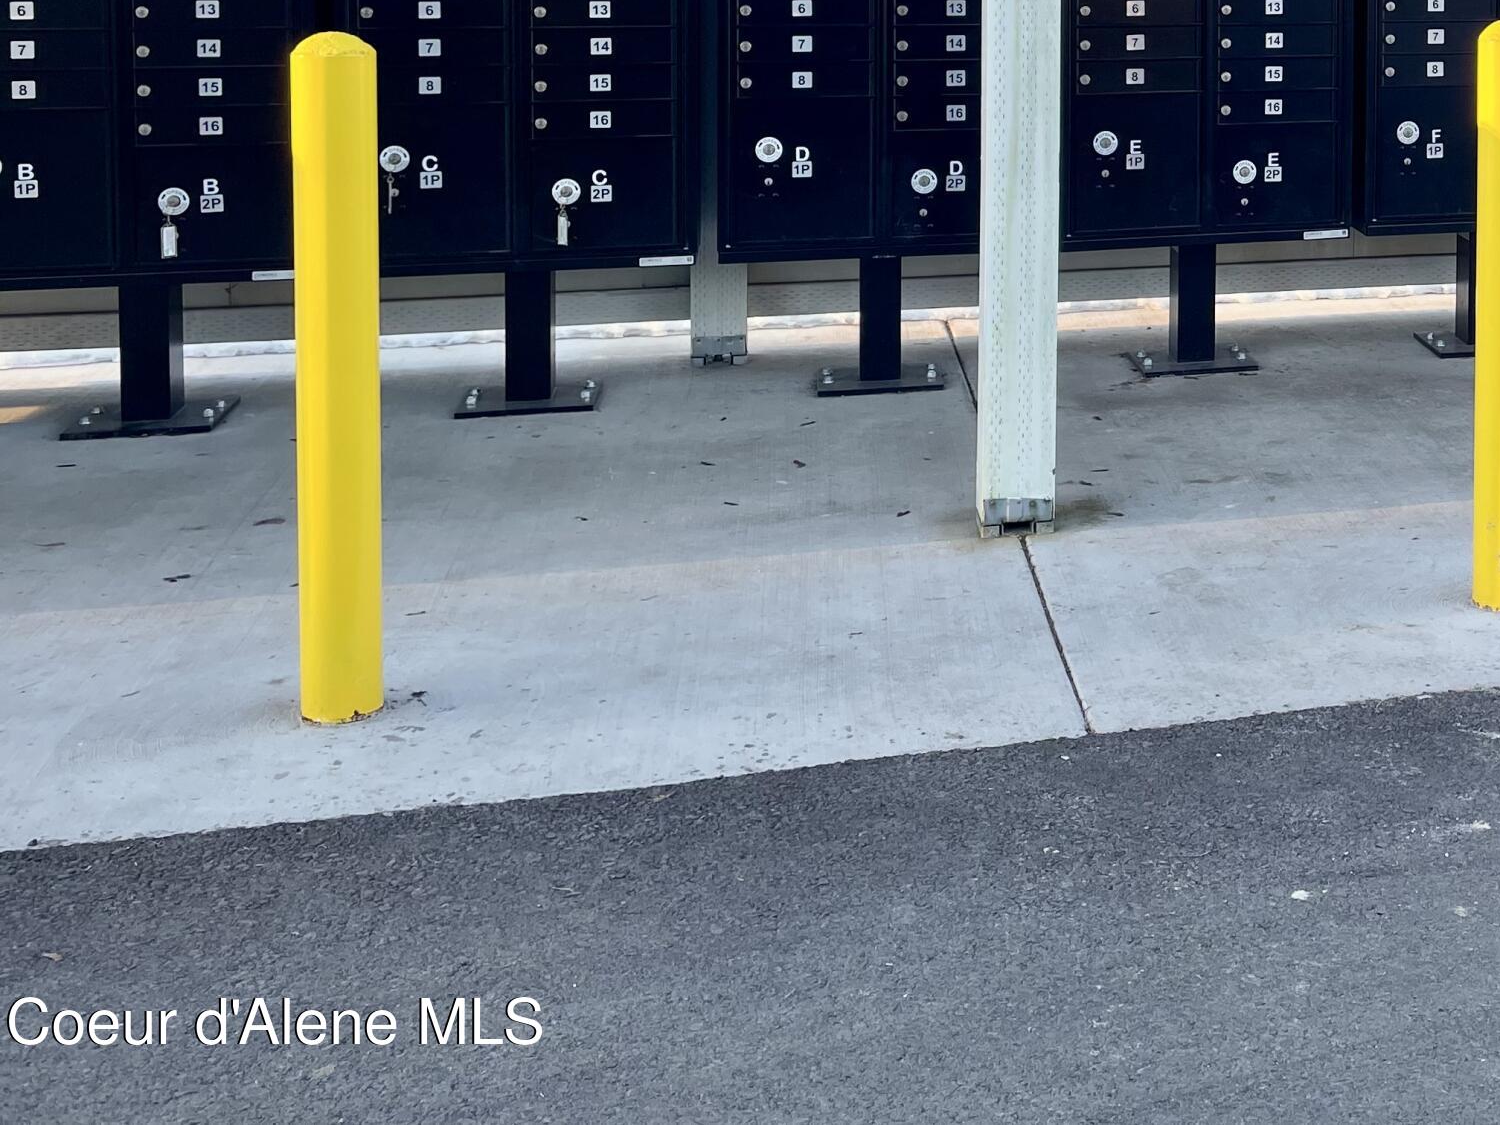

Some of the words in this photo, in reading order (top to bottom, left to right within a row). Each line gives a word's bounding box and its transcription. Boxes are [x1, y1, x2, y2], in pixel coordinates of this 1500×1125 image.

[16, 5, 27, 17] 6
[198, 3, 216, 15] 13
[425, 5, 434, 16] 6
[592, 4, 608, 16] 13
[797, 3, 806, 14] 6
[949, 2, 963, 13] 13
[1268, 2, 1281, 12] 13
[593, 40, 610, 52] 14
[797, 38, 806, 50] 7
[949, 38, 963, 49] 14
[1268, 35, 1281, 46] 14
[17, 44, 27, 56] 7
[199, 42, 217, 54] 14
[425, 42, 434, 54] 7
[949, 73, 963, 84] 15
[1267, 69, 1280, 79] 15
[426, 80, 434, 92] 8
[592, 77, 609, 89] 15
[797, 75, 806, 86] 8
[18, 84, 28, 96] 8
[201, 81, 219, 93] 15
[949, 107, 963, 119] 16
[1267, 102, 1280, 112] 16
[202, 120, 220, 132] 16
[592, 114, 609, 126] 16
[1431, 128, 1442, 143] F
[1129, 139, 1142, 154] E
[1428, 145, 1441, 156] 1P
[795, 146, 810, 161] D
[1267, 152, 1280, 167] E
[421, 155, 439, 171] C
[949, 160, 964, 175] D
[1128, 156, 1142, 167] 1P
[17, 163, 35, 180] B
[794, 164, 810, 175] 1P
[1266, 169, 1280, 180] 2P
[422, 174, 440, 186] 1P
[591, 169, 608, 185] C
[16, 183, 36, 195] 1P
[202, 178, 220, 195] B
[948, 178, 963, 189] 2P
[593, 188, 610, 200] 2P
[202, 197, 222, 210] 2P
